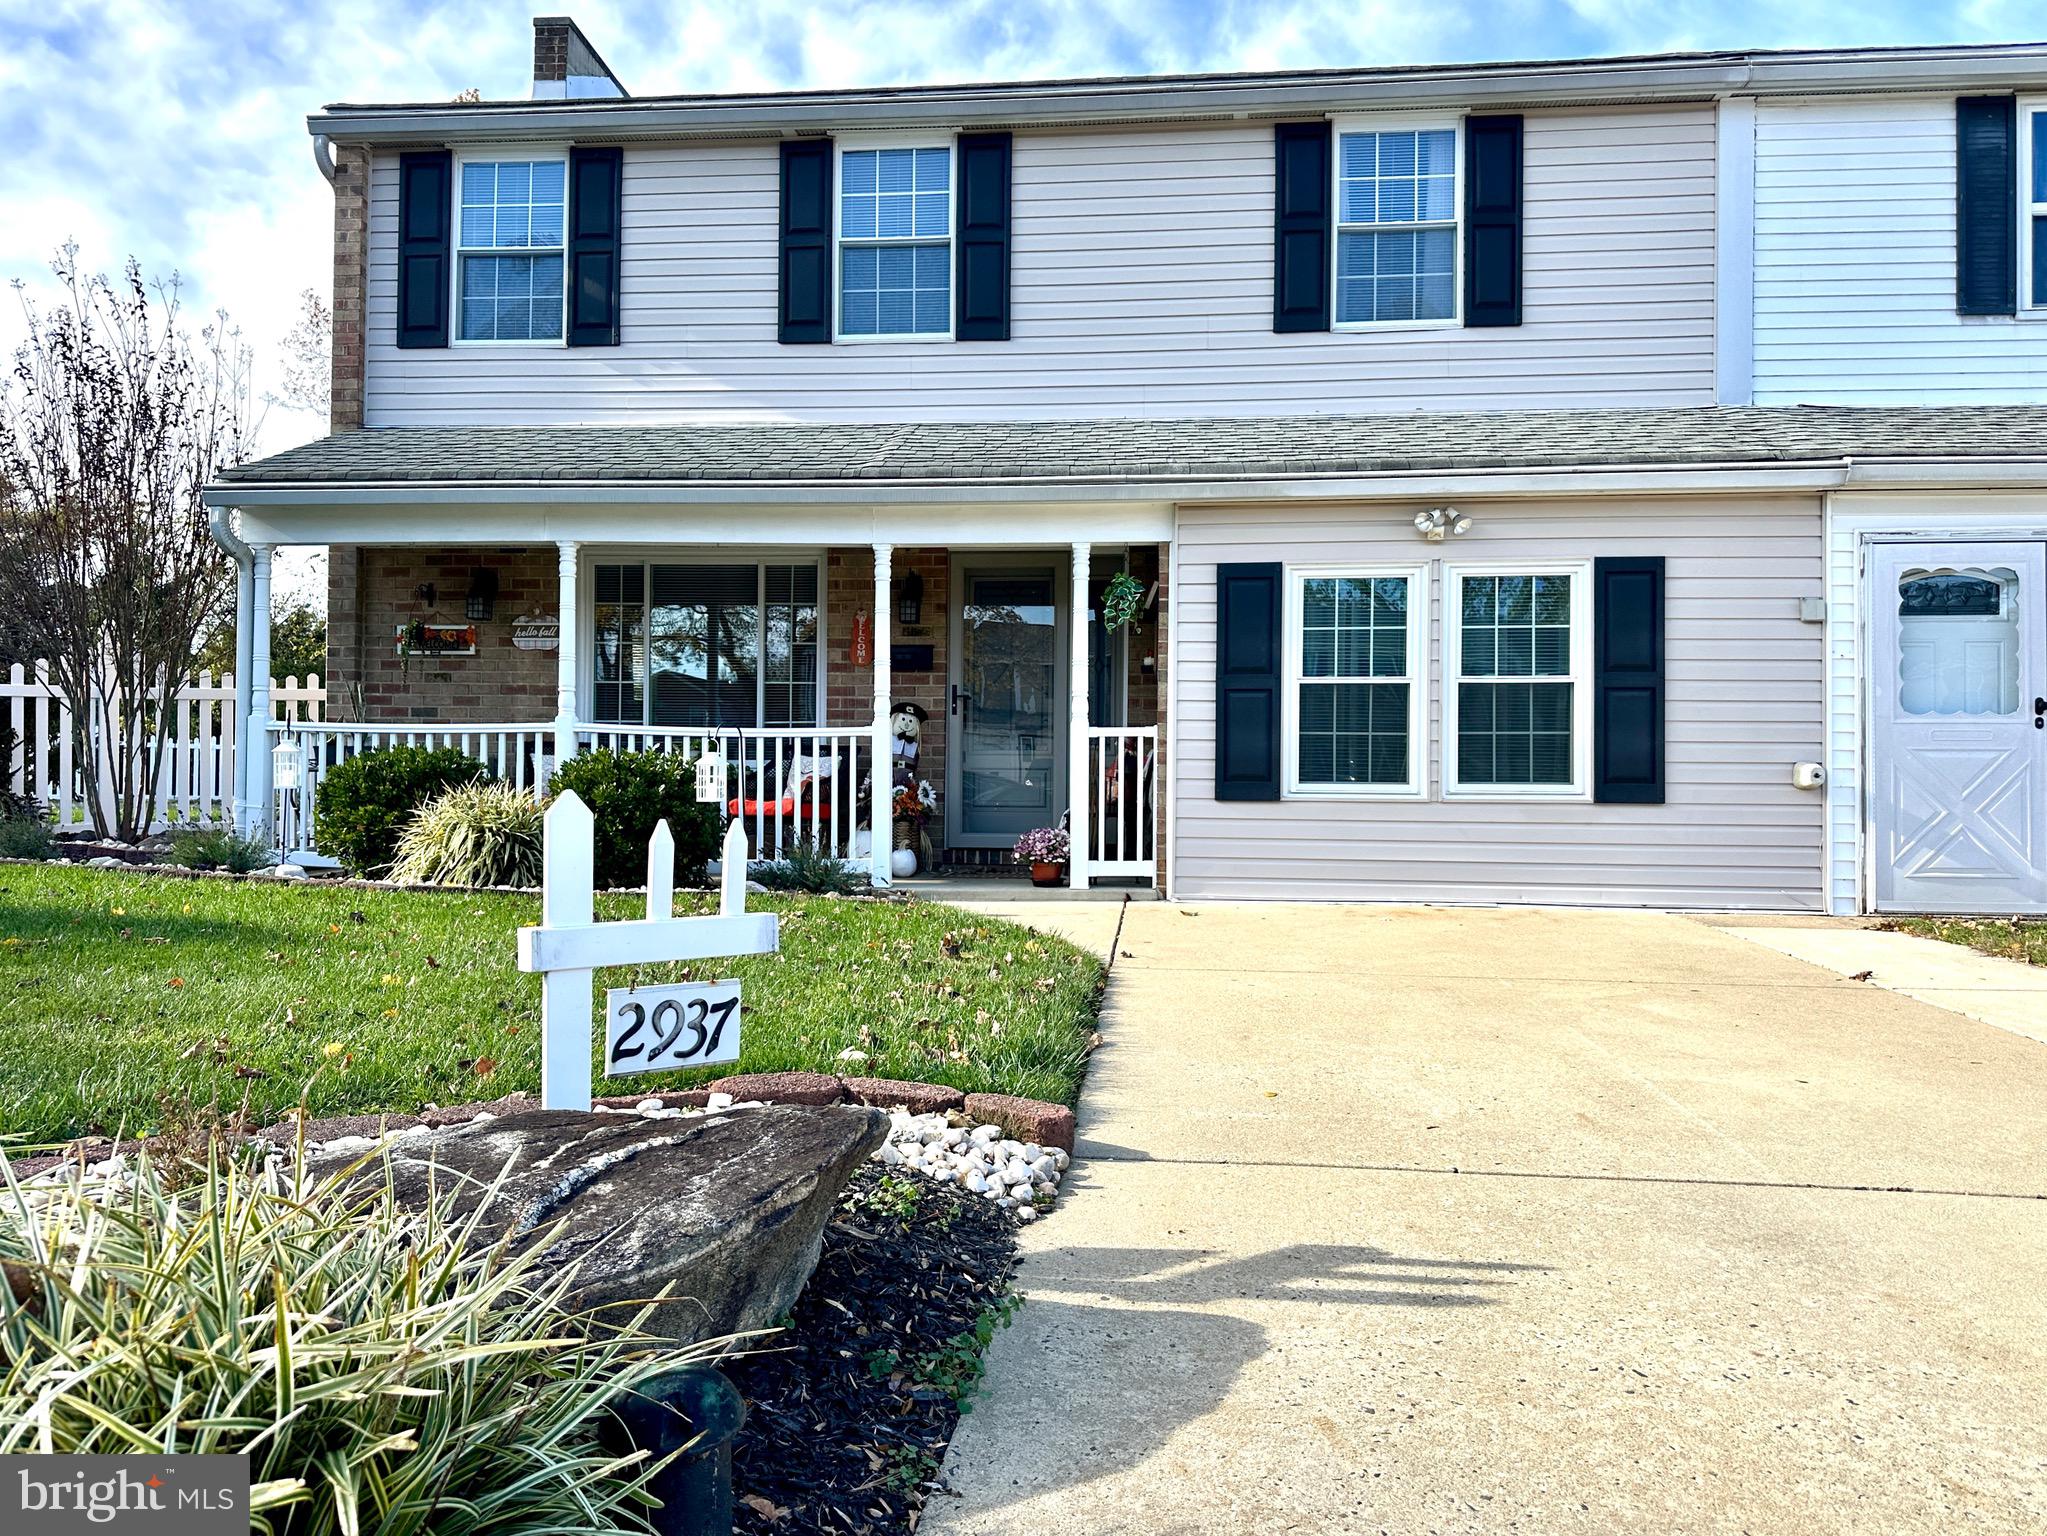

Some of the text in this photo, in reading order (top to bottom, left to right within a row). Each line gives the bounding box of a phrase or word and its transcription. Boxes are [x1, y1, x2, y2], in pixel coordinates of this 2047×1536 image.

[514, 626, 558, 638] hello fall
[856, 615, 867, 664] WELCOME
[611, 997, 739, 1063] 2937
